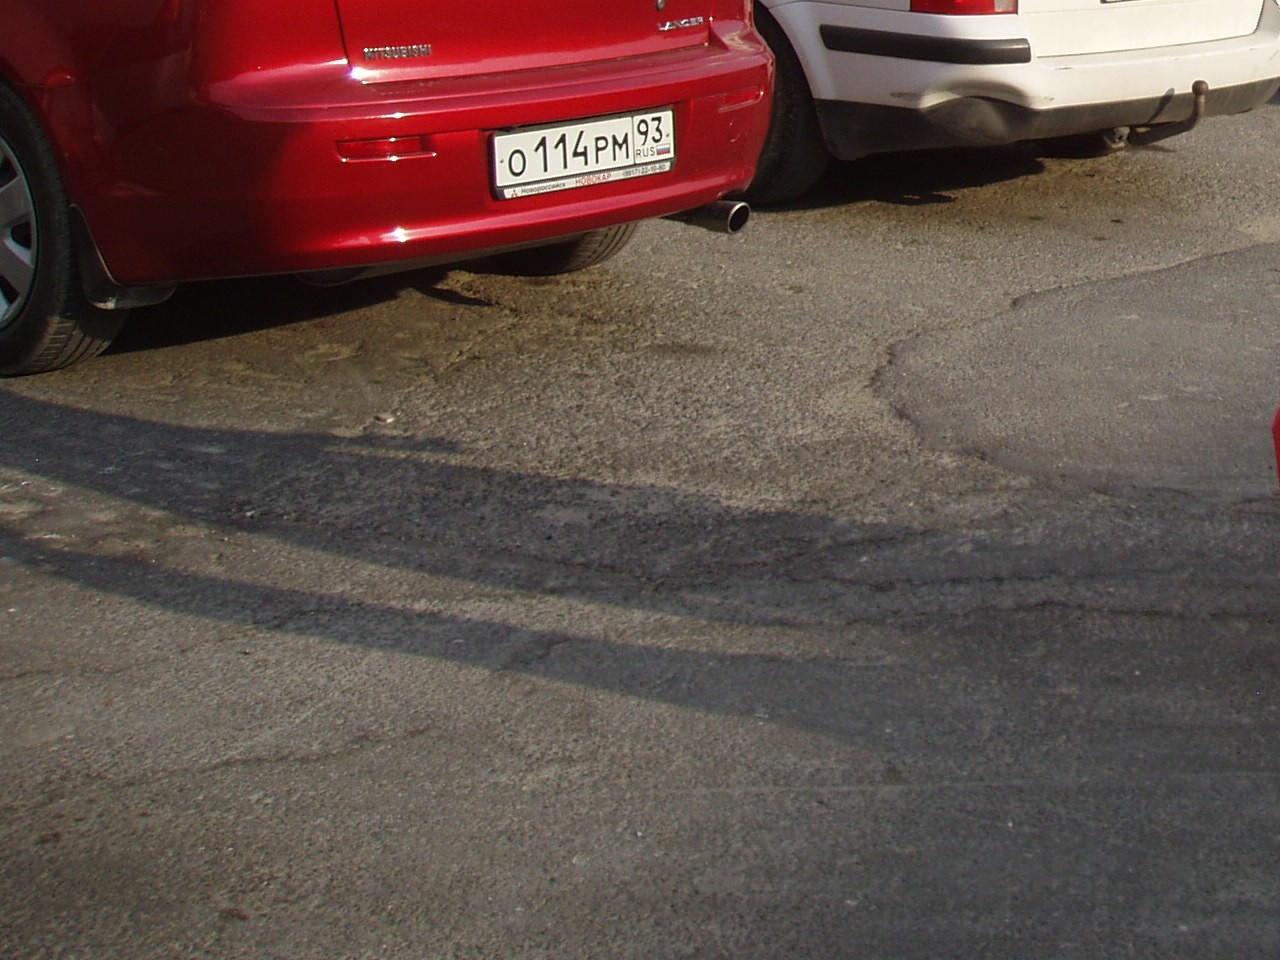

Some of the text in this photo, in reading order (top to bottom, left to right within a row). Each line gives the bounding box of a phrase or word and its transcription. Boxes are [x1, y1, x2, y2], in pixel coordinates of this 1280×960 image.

[656, 16, 704, 31] LANCER
[363, 43, 432, 60] MITSUBISHI
[636, 116, 663, 146] 93
[636, 146, 655, 158] RUS
[575, 172, 612, 186] НОВОКАР
